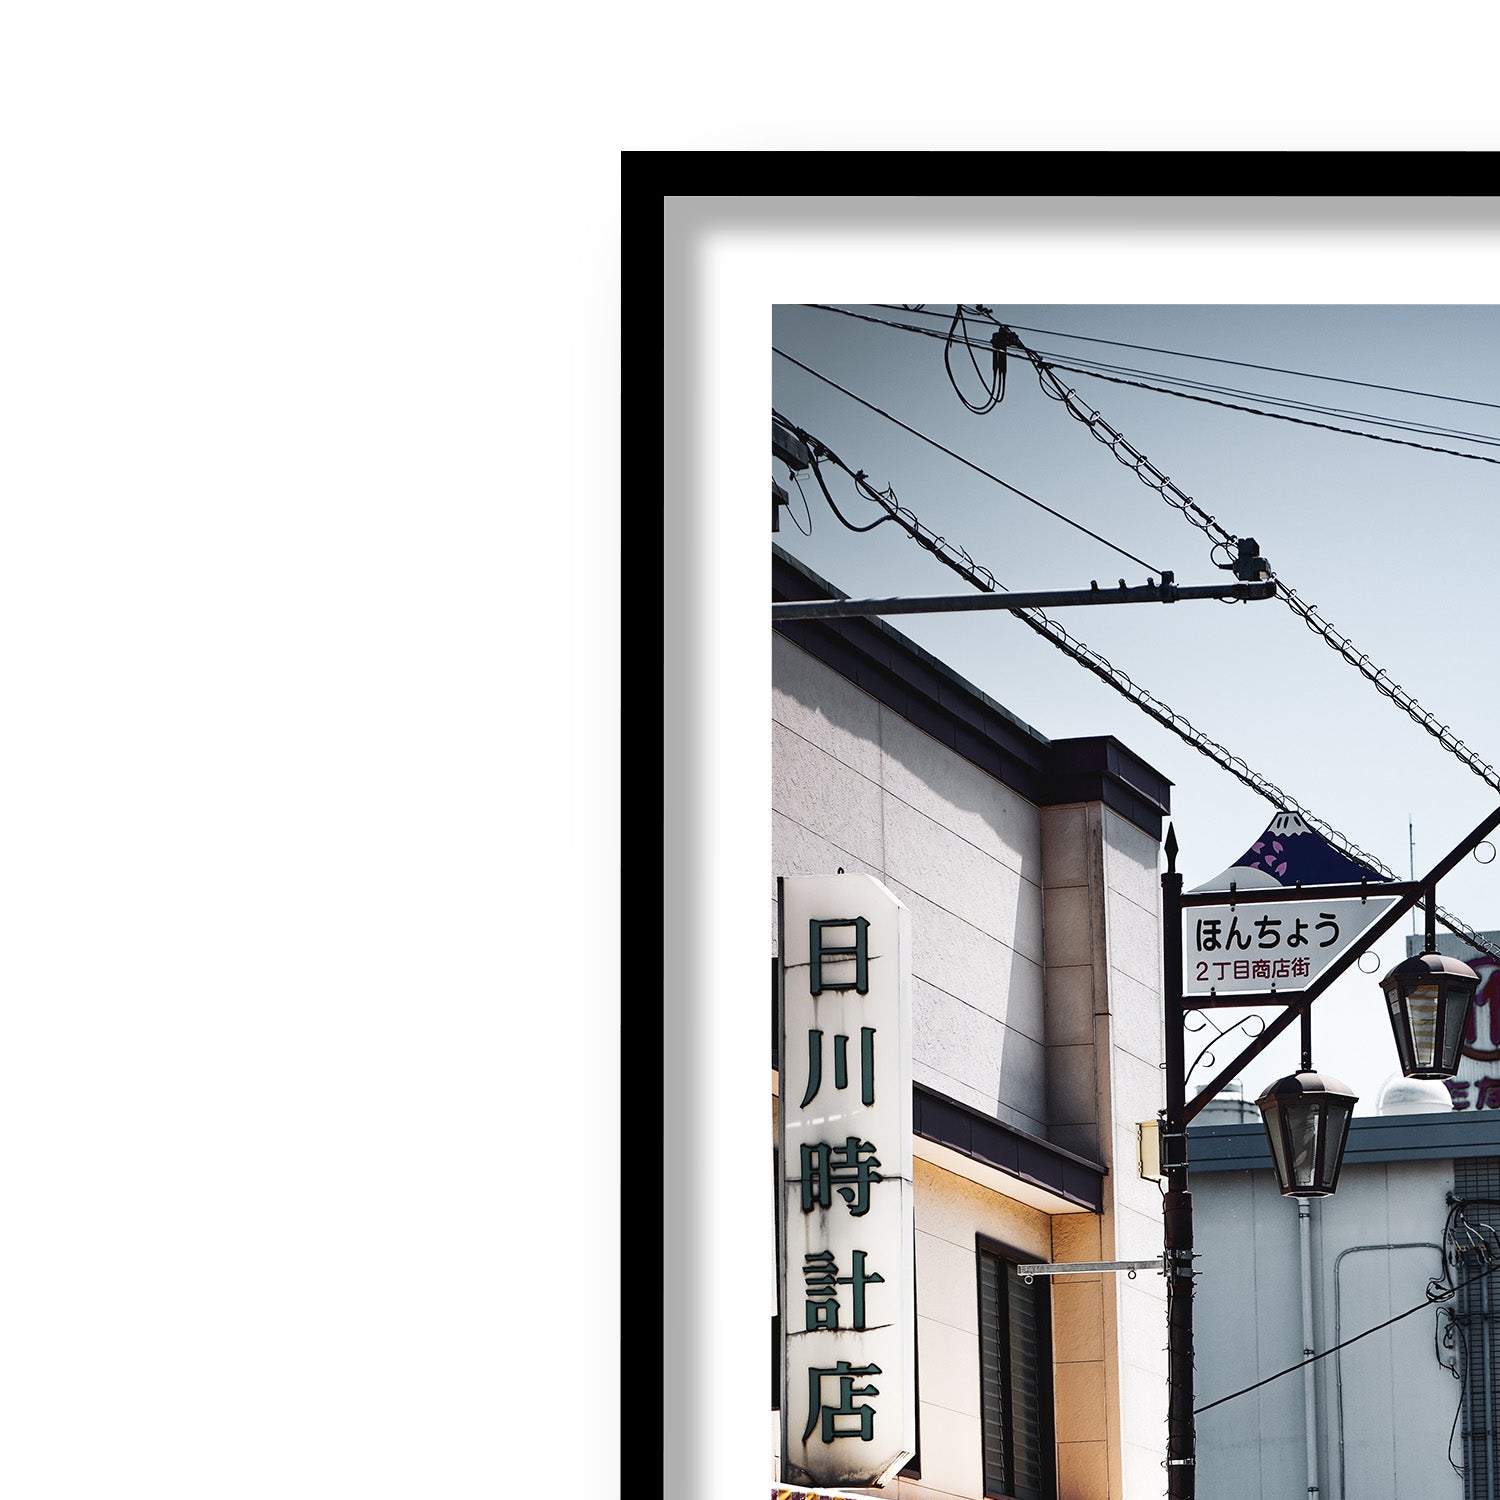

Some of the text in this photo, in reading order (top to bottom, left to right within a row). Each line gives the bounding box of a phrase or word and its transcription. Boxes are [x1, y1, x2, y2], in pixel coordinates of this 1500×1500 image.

[1196, 912, 1340, 952] ほんちょう
[1196, 957, 1310, 981] 2丁目商店街
[799, 915, 885, 1445] 日川時計店
